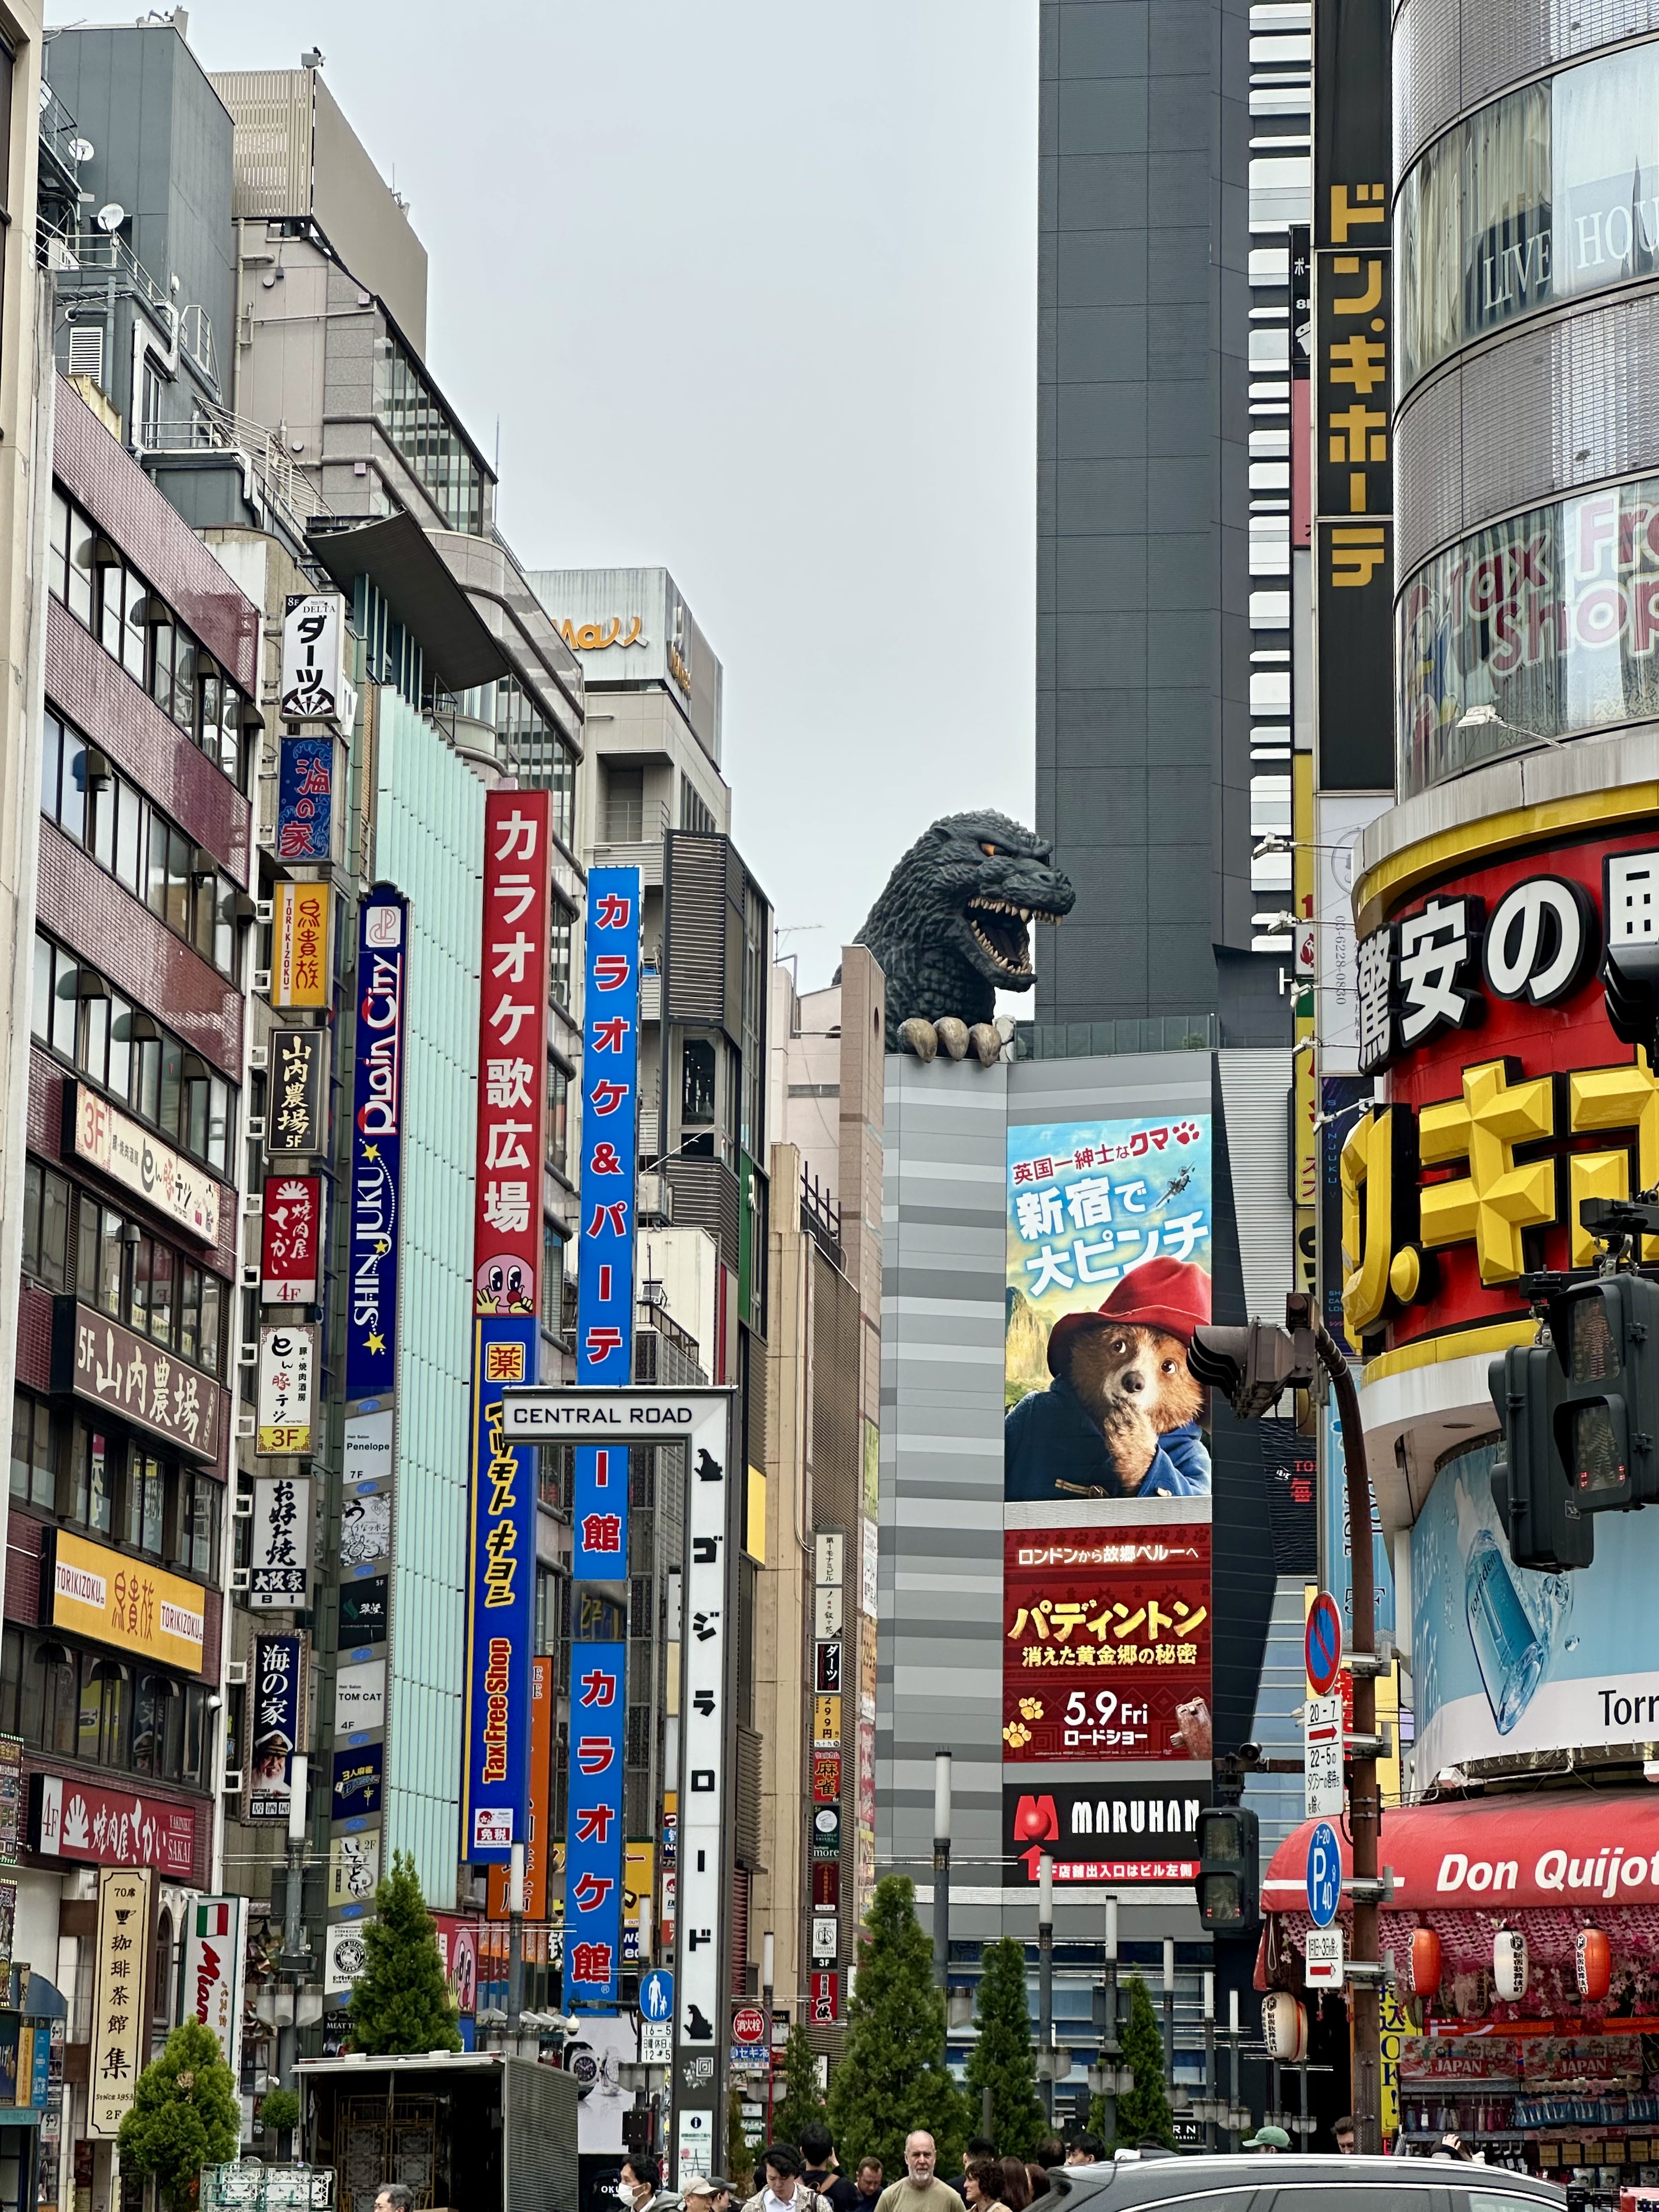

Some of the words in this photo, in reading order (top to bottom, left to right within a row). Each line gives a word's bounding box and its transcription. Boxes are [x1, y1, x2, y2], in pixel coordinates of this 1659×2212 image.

[1484, 228, 1552, 310] LIVE
[1296, 299, 1310, 309] 8
[1330, 183, 1386, 587] ドン・キホーテ
[288, 597, 299, 607] 8F
[303, 605, 336, 613] DELTA
[296, 615, 327, 695] ダーツ
[280, 759, 331, 857] 海の家
[283, 898, 292, 985] TORIKIZOKU
[1335, 915, 1346, 1005] 03-6228-0830
[484, 810, 537, 1232] カラオケ歌広場
[277, 1035, 312, 1135] 山内農場
[84, 1102, 105, 1154] 3F
[286, 1135, 302, 1147] 5F
[1013, 1126, 1169, 1185] 英国一紳士なクマ
[1016, 1177, 1147, 1241] 新宿で
[290, 1200, 313, 1259] 焼肉屋
[354, 1166, 393, 1326] SHINJUKU
[1027, 1210, 1209, 1297] 大ピンチ
[277, 1282, 301, 1301] 4F
[78, 1326, 95, 1373] 5F
[490, 1347, 521, 1378] 薬
[96, 1328, 200, 1444] 山内農場
[514, 1407, 621, 1424] CENTRAL
[630, 1407, 693, 1424] ROAD
[271, 1428, 299, 1447] 3F
[346, 1442, 390, 1452] Penelope
[350, 1470, 364, 1479] 7F
[266, 1480, 297, 1567] お好み焼
[825, 1537, 834, 1582] 第1モナミビル
[1019, 1545, 1199, 1565] ロンドンから故郷ペルーへ
[57, 1566, 101, 1604] TORIKIZOKU
[255, 1570, 303, 1592] 大阪家
[162, 1605, 200, 1639] TORIKIZOKU
[1007, 1599, 1207, 1643] パディントン
[485, 1638, 512, 1694] Shop
[826, 1644, 839, 1682] ダーツ
[1022, 1644, 1197, 1668] 消えた黄金郷の秘密
[261, 1644, 291, 1726] 海の家
[362, 1693, 382, 1701] CAT
[341, 1721, 354, 1730] 4F
[485, 1693, 509, 1744] Free
[822, 1696, 833, 1739] 299円
[1063, 1692, 1117, 1726] 5.9
[1121, 1704, 1148, 1725] Fri
[688, 1535, 724, 1951] ゴジラロード
[1064, 1730, 1148, 1747] ロードショー
[483, 1743, 508, 1784] Tax
[815, 1760, 838, 1796] 麻雀
[1308, 1769, 1340, 1791] タクシーの客待ち
[42, 1792, 58, 1838] 4F
[571, 1669, 617, 1984] カラオケ館
[1071, 1799, 1199, 1835] MARUHAN
[168, 1839, 191, 1863] SAKAI
[364, 1840, 377, 1850] 2F
[481, 1828, 507, 1841] 免税
[813, 1849, 839, 1858] more
[1313, 1847, 1327, 1911] P
[1437, 1852, 1518, 1892] Don
[114, 1887, 136, 1898] 70席
[1322, 1881, 1332, 1910] 40
[819, 1958, 830, 1967] 3F
[1513, 1951, 1524, 1993] 新宿歌舞伎町
[737, 2018, 761, 2033] 消火栓
[1435, 2060, 1482, 2073] JAPAN
[1560, 2059, 1607, 2074] JAPAN
[117, 2092, 134, 2101] 1953
[105, 2110, 122, 2121] 2F
